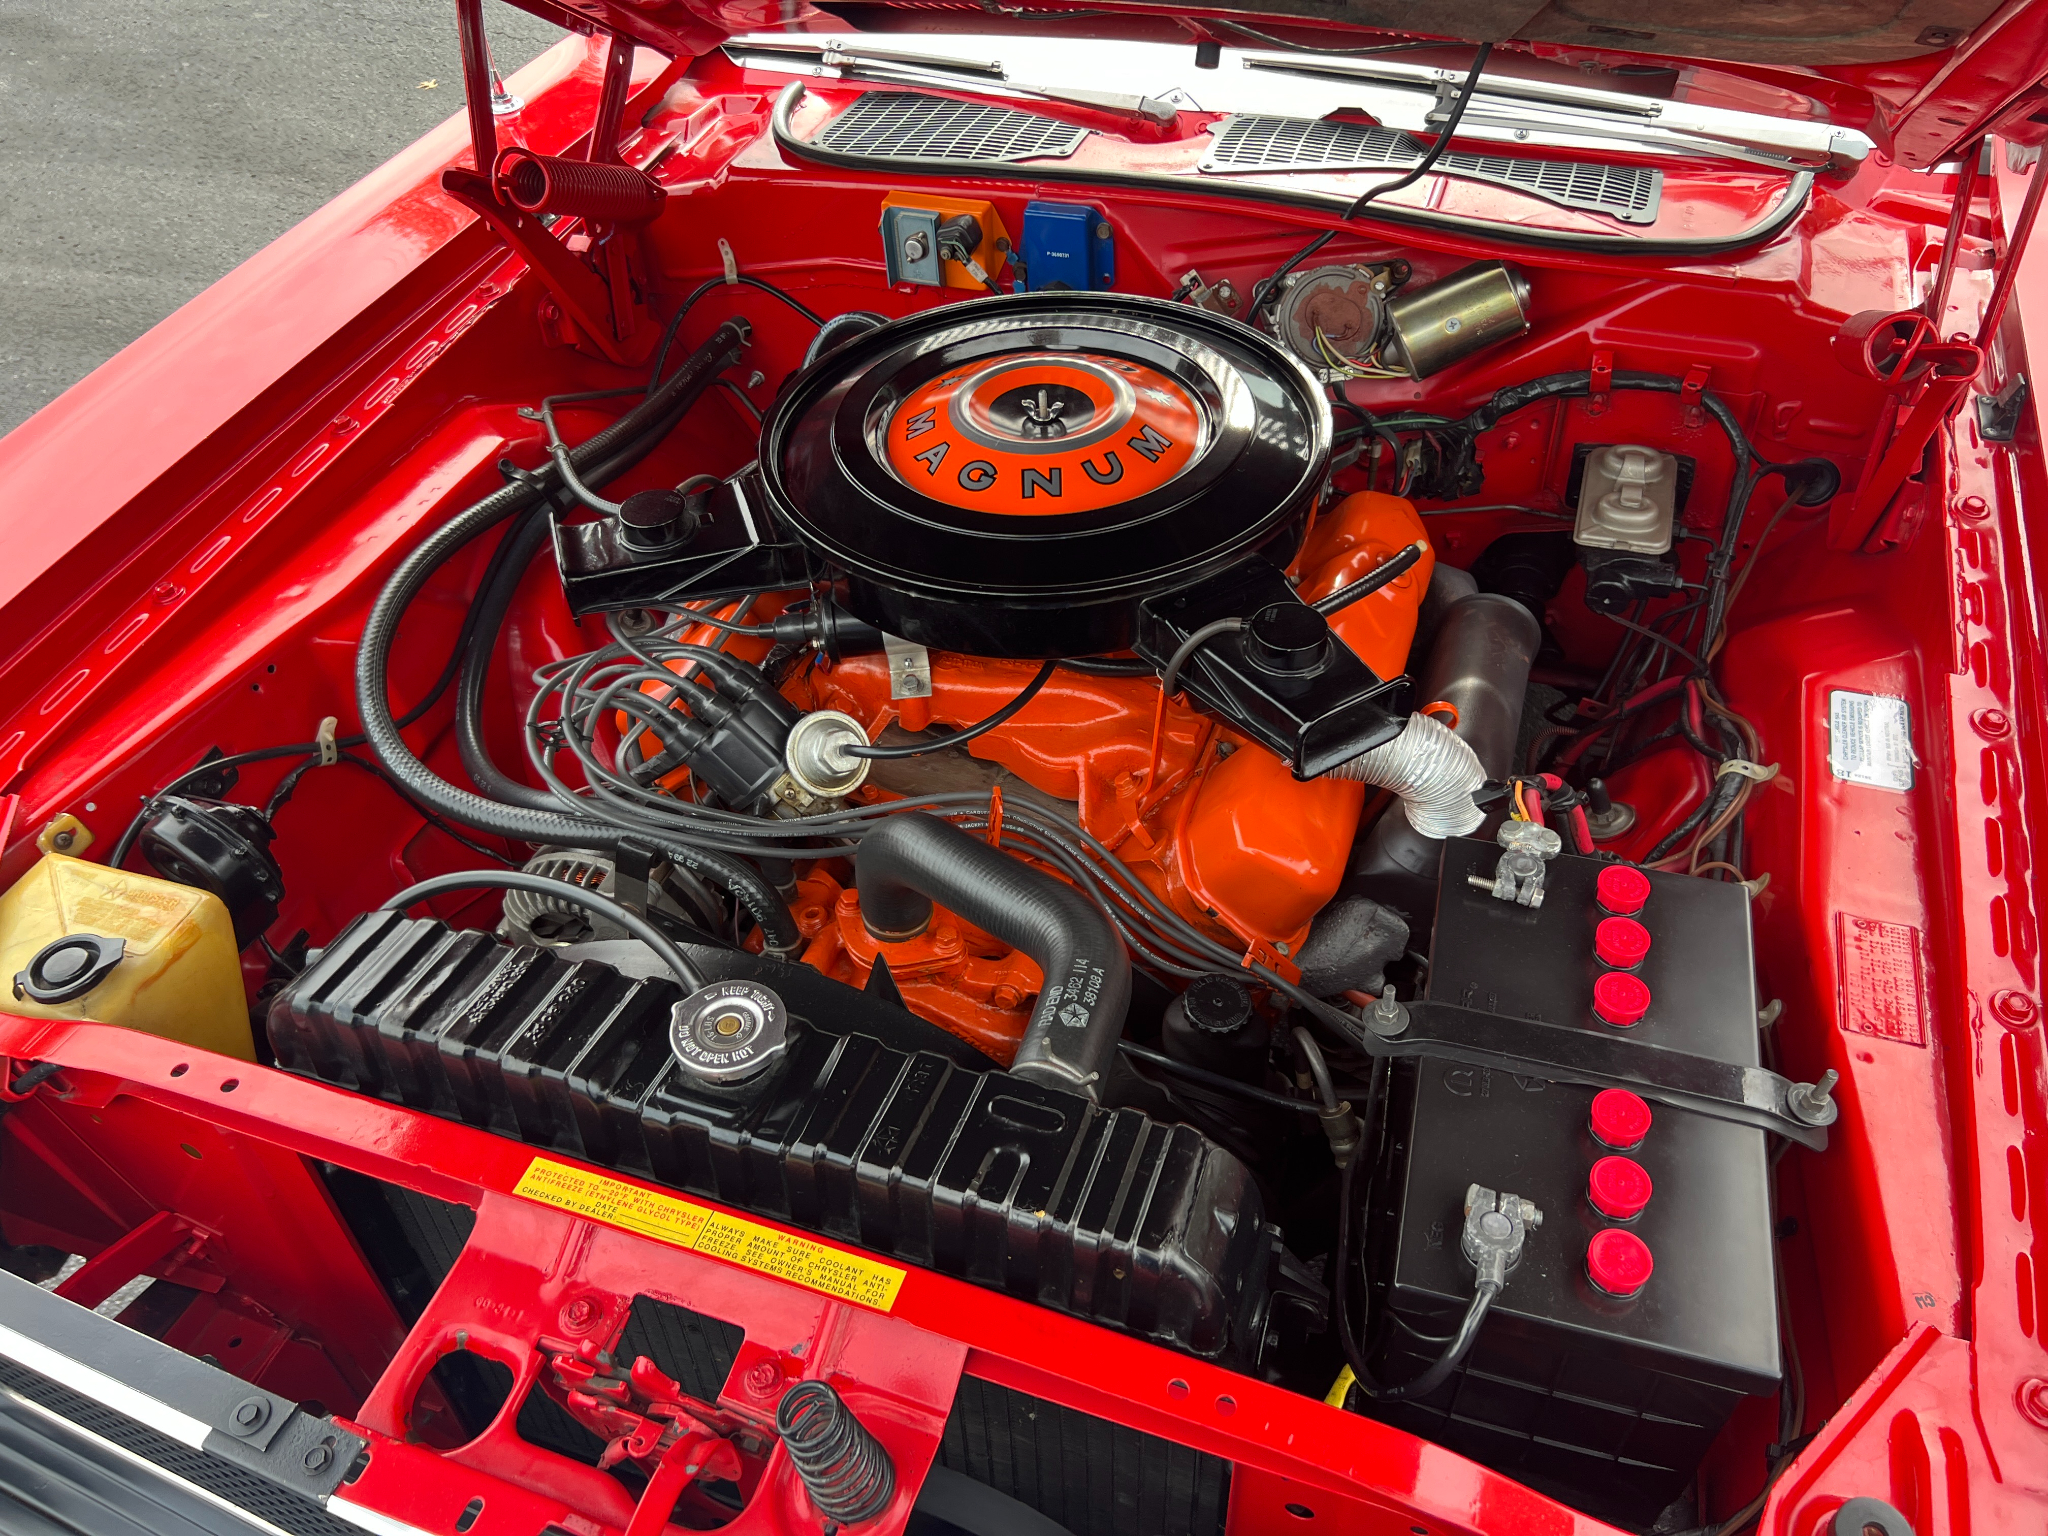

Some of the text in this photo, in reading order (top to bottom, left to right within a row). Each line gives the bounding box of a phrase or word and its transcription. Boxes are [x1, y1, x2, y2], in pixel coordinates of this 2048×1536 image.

[905, 406, 1173, 499] MAGNUM
[721, 985, 775, 1012] KEEP TIGHT
[1063, 976, 1084, 1001] 3462
[678, 1025, 755, 1065] DO NOT OPEN HOT
[522, 1186, 617, 1221] CHECKED BY DEALER:
[529, 1173, 701, 1232] ANTIFREEZE (ETHYLENE GLYCOL TYPE)
[534, 1167, 586, 1187] PROTECTED
[588, 1183, 600, 1191] TO
[633, 1197, 656, 1209] WITH
[657, 1204, 705, 1224] CHRYSLER
[594, 1201, 619, 1213] DATE
[598, 1179, 653, 1199] IMPORTANT
[704, 1228, 888, 1292] PROPER AMOUNT OF CHRYSLER ANTI-
[709, 1221, 892, 1285] ALWAYS MAKE SURE COOLANT HAS
[777, 1234, 825, 1254] WARNING
[697, 1241, 881, 1307] COOLING SYSTEMS RECOMMENDATIONS.
[745, 1248, 765, 1260] SEE
[770, 1256, 813, 1276] OWNER'S
[819, 1273, 858, 1291] MANUAL
[865, 1288, 886, 1300] FOR
